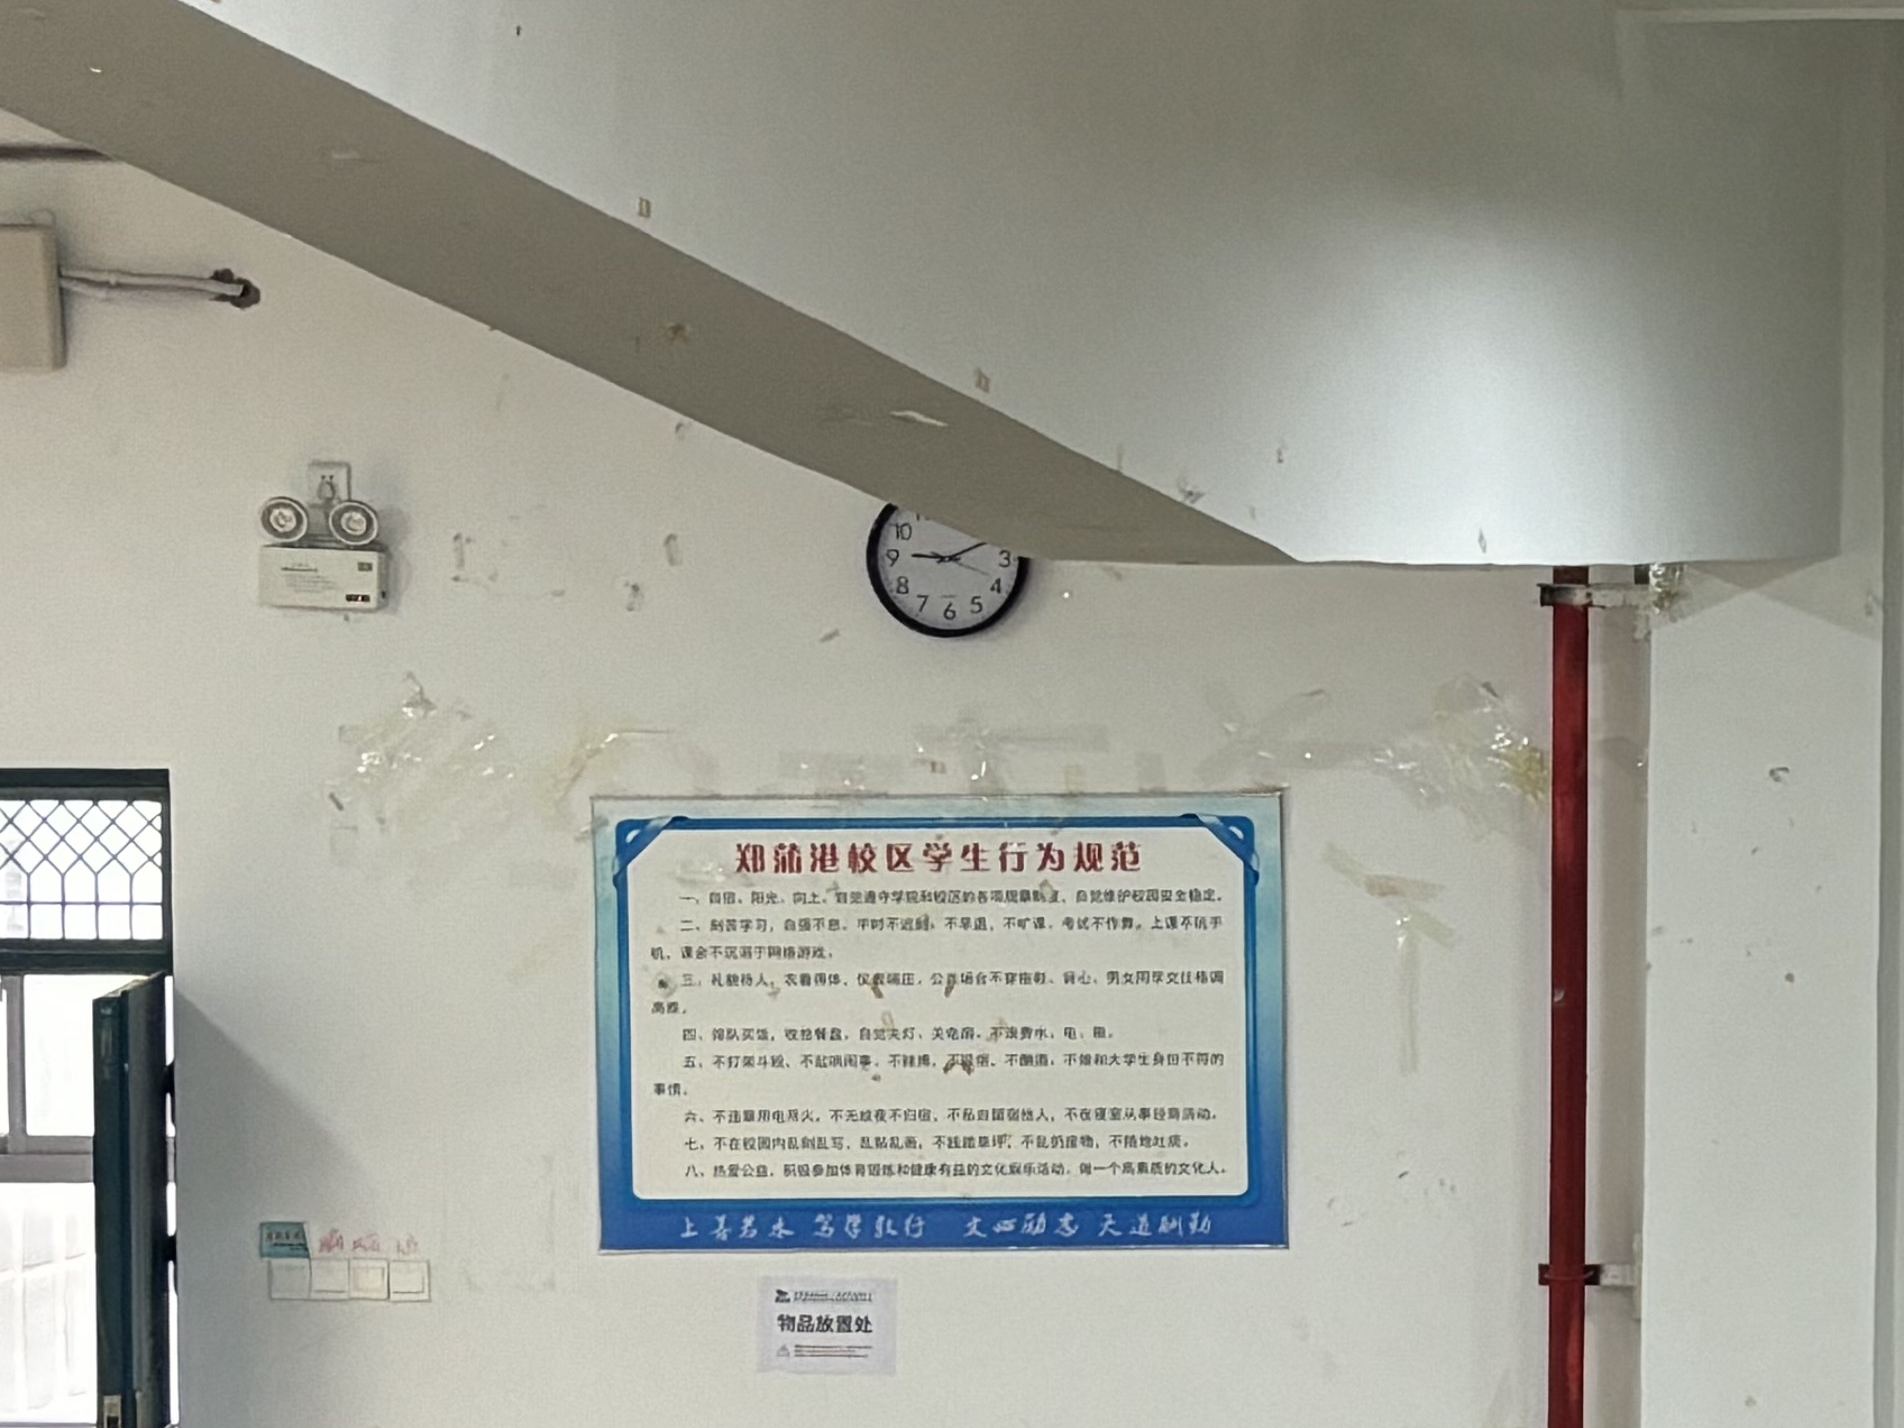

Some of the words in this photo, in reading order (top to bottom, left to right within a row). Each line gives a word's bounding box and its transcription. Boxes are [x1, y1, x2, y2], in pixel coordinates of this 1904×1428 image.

[894, 523, 913, 541] 10
[886, 549, 900, 567] 9
[999, 550, 1011, 568] 3
[896, 576, 909, 594] 8
[989, 578, 1002, 593] 4
[916, 595, 929, 612] 7
[943, 602, 957, 620] 6
[970, 596, 983, 613] 5
[736, 842, 1141, 874] 郑蒲港校区学生行为规范
[777, 1314, 873, 1333] 物品放置处
